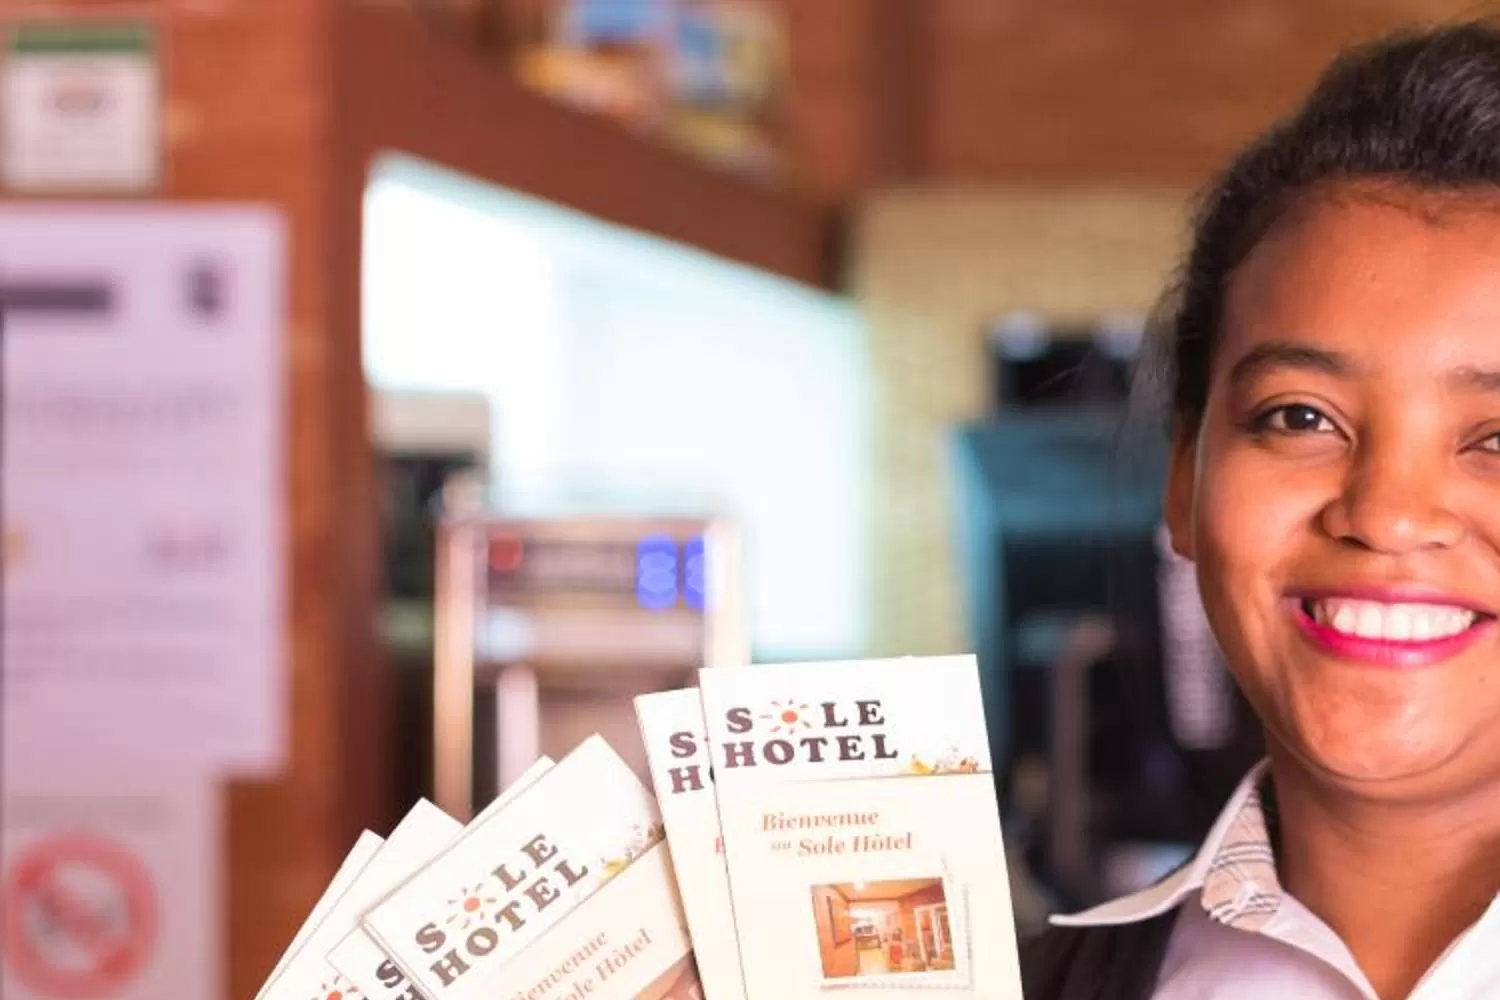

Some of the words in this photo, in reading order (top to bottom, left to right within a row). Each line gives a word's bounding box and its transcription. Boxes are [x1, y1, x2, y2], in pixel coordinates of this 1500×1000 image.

[722, 734, 899, 769] HOTEL
[761, 811, 879, 832] Bienvenue
[797, 836, 845, 858] Sole
[429, 859, 589, 988] HOTEL
